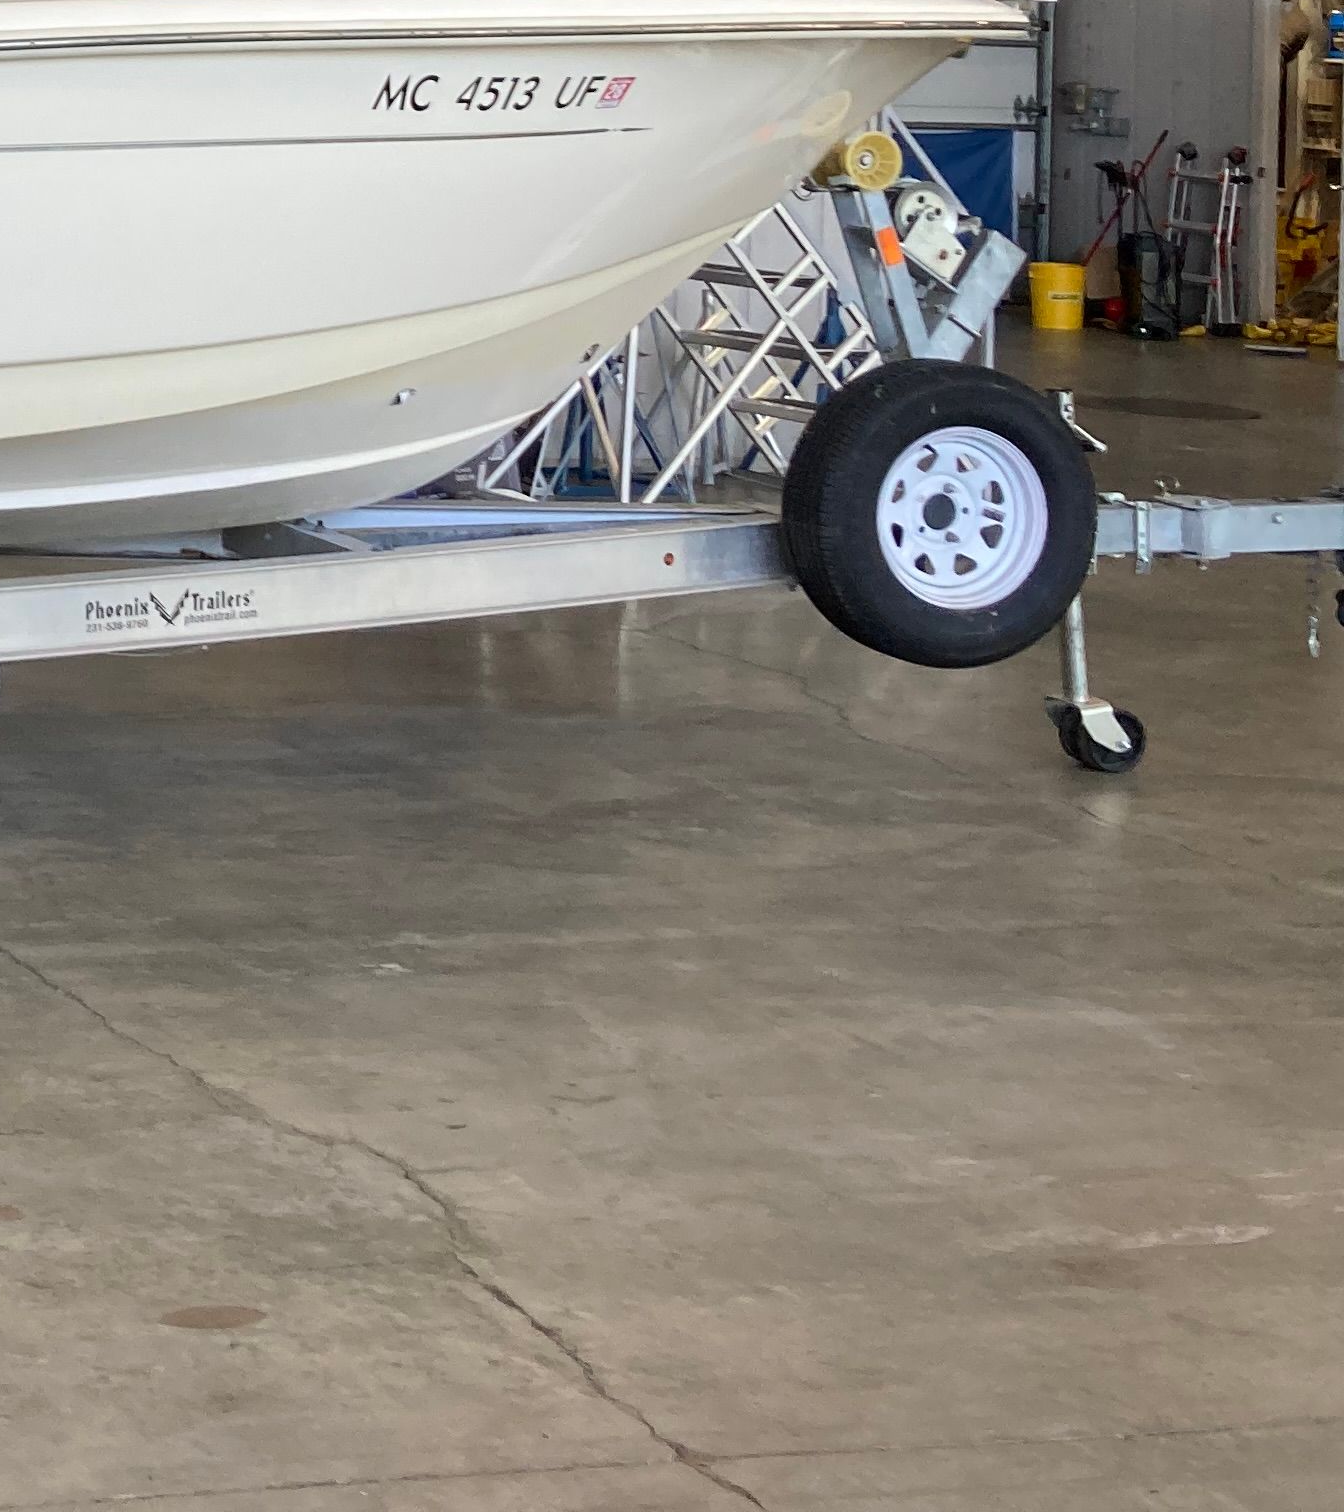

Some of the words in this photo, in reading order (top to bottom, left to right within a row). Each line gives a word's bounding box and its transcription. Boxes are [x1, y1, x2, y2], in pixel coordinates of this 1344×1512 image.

[372, 74, 440, 111] MC
[456, 76, 541, 111] 4513
[554, 75, 607, 109] UF
[85, 597, 150, 620] Phoenix
